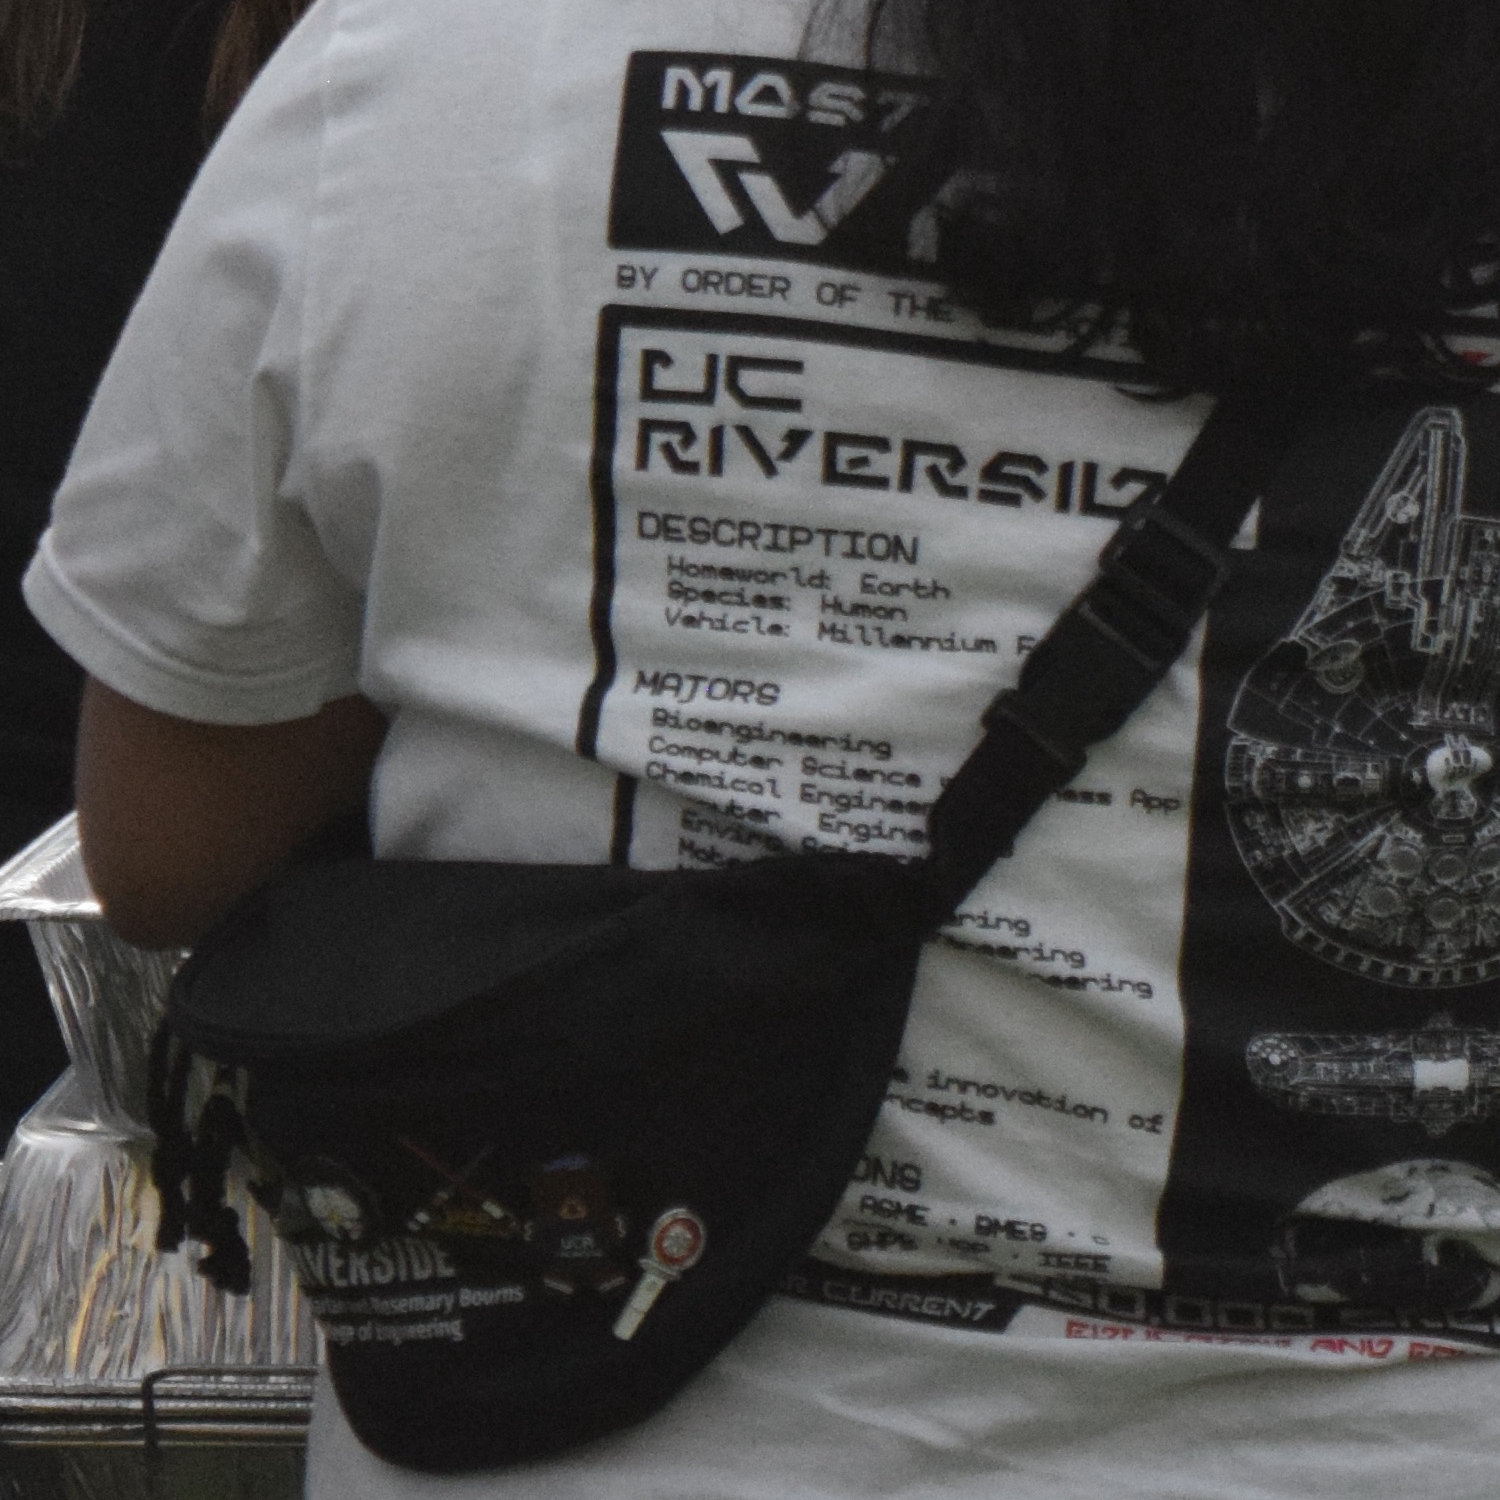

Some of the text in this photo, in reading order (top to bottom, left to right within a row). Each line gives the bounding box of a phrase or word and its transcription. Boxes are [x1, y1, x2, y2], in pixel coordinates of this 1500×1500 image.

[615, 263, 660, 290] BY
[681, 267, 793, 300] ORDER
[816, 280, 861, 310] OF
[639, 347, 806, 414] UC
[634, 416, 1170, 520] RIVERSID
[637, 510, 919, 565] DESCRIPTION
[633, 668, 781, 706] MAJORS
[646, 761, 782, 800] Chemical
[650, 735, 784, 770] Computer
[801, 755, 922, 790] Science
[926, 1068, 1164, 1136] innovation of
[458, 1284, 526, 1309] Bourns
